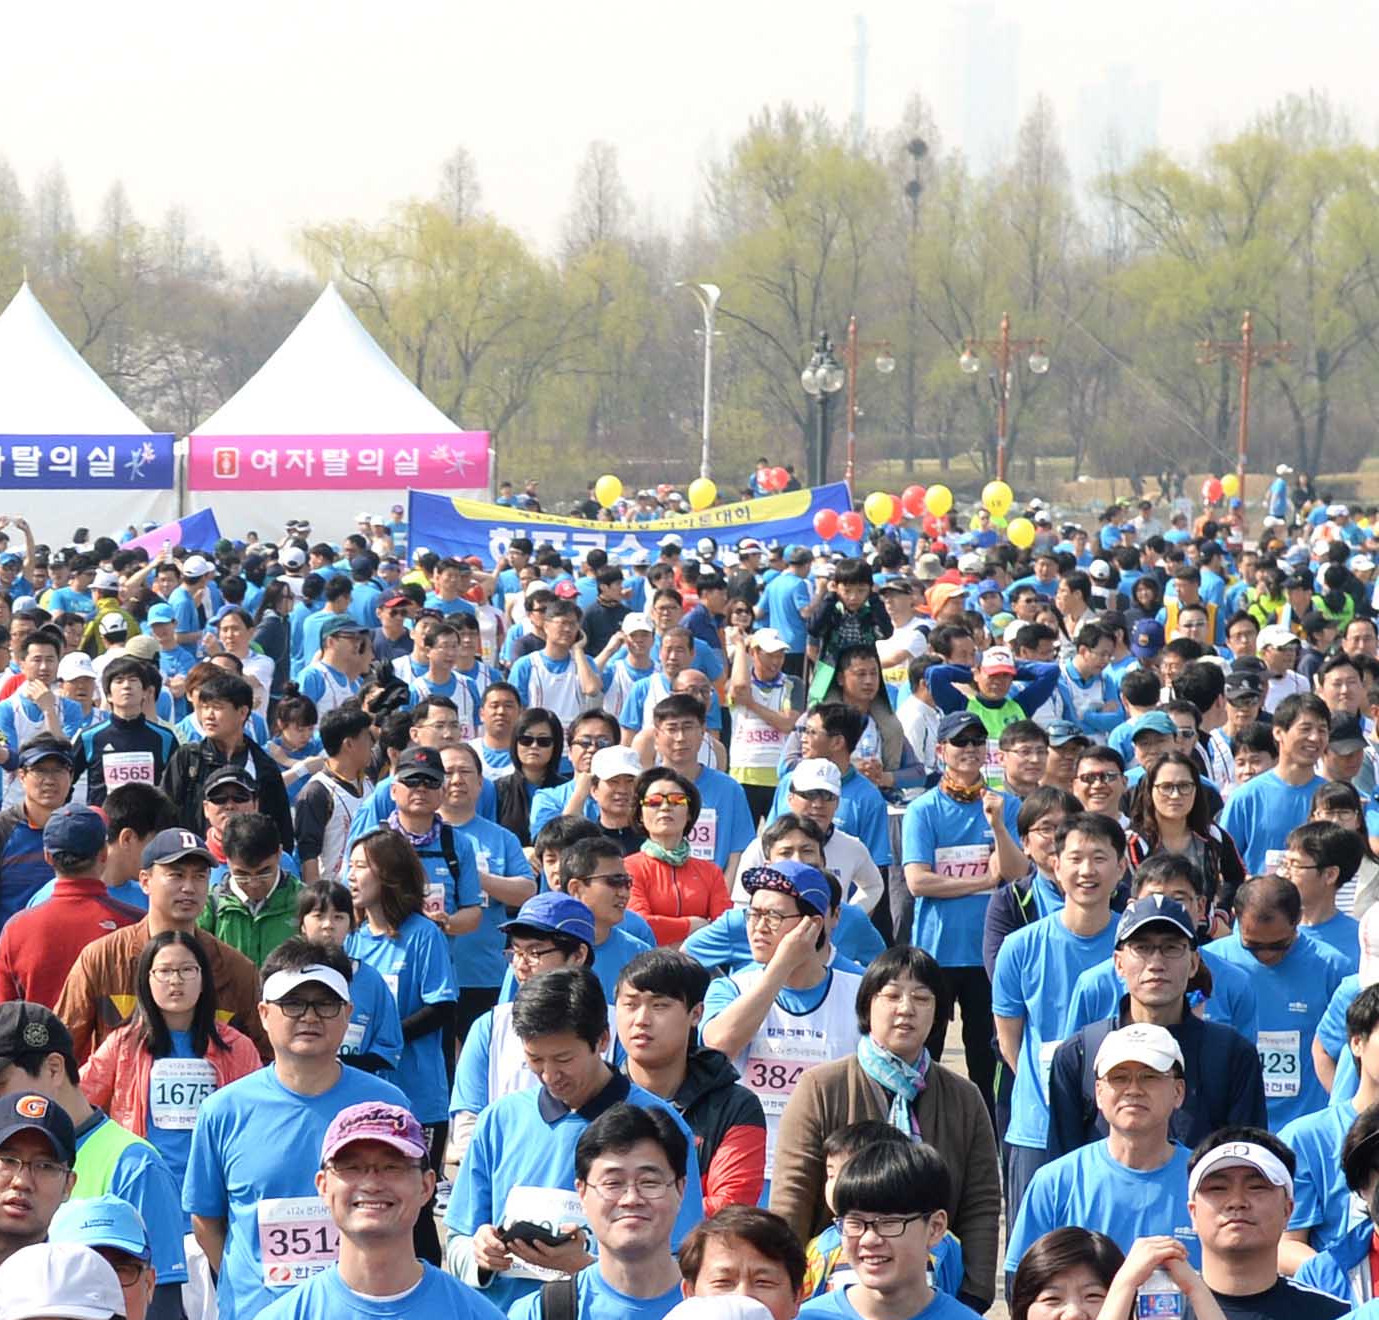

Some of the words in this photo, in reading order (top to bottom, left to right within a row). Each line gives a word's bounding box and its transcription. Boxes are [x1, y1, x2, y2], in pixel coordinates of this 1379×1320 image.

[250, 445, 421, 477] 여자탈의실
[746, 731, 780, 743] 3358
[109, 765, 151, 782] 4565
[179, 831, 197, 848] D
[766, 1026, 825, 1041] 한국전력기술
[16, 1095, 49, 1118] G
